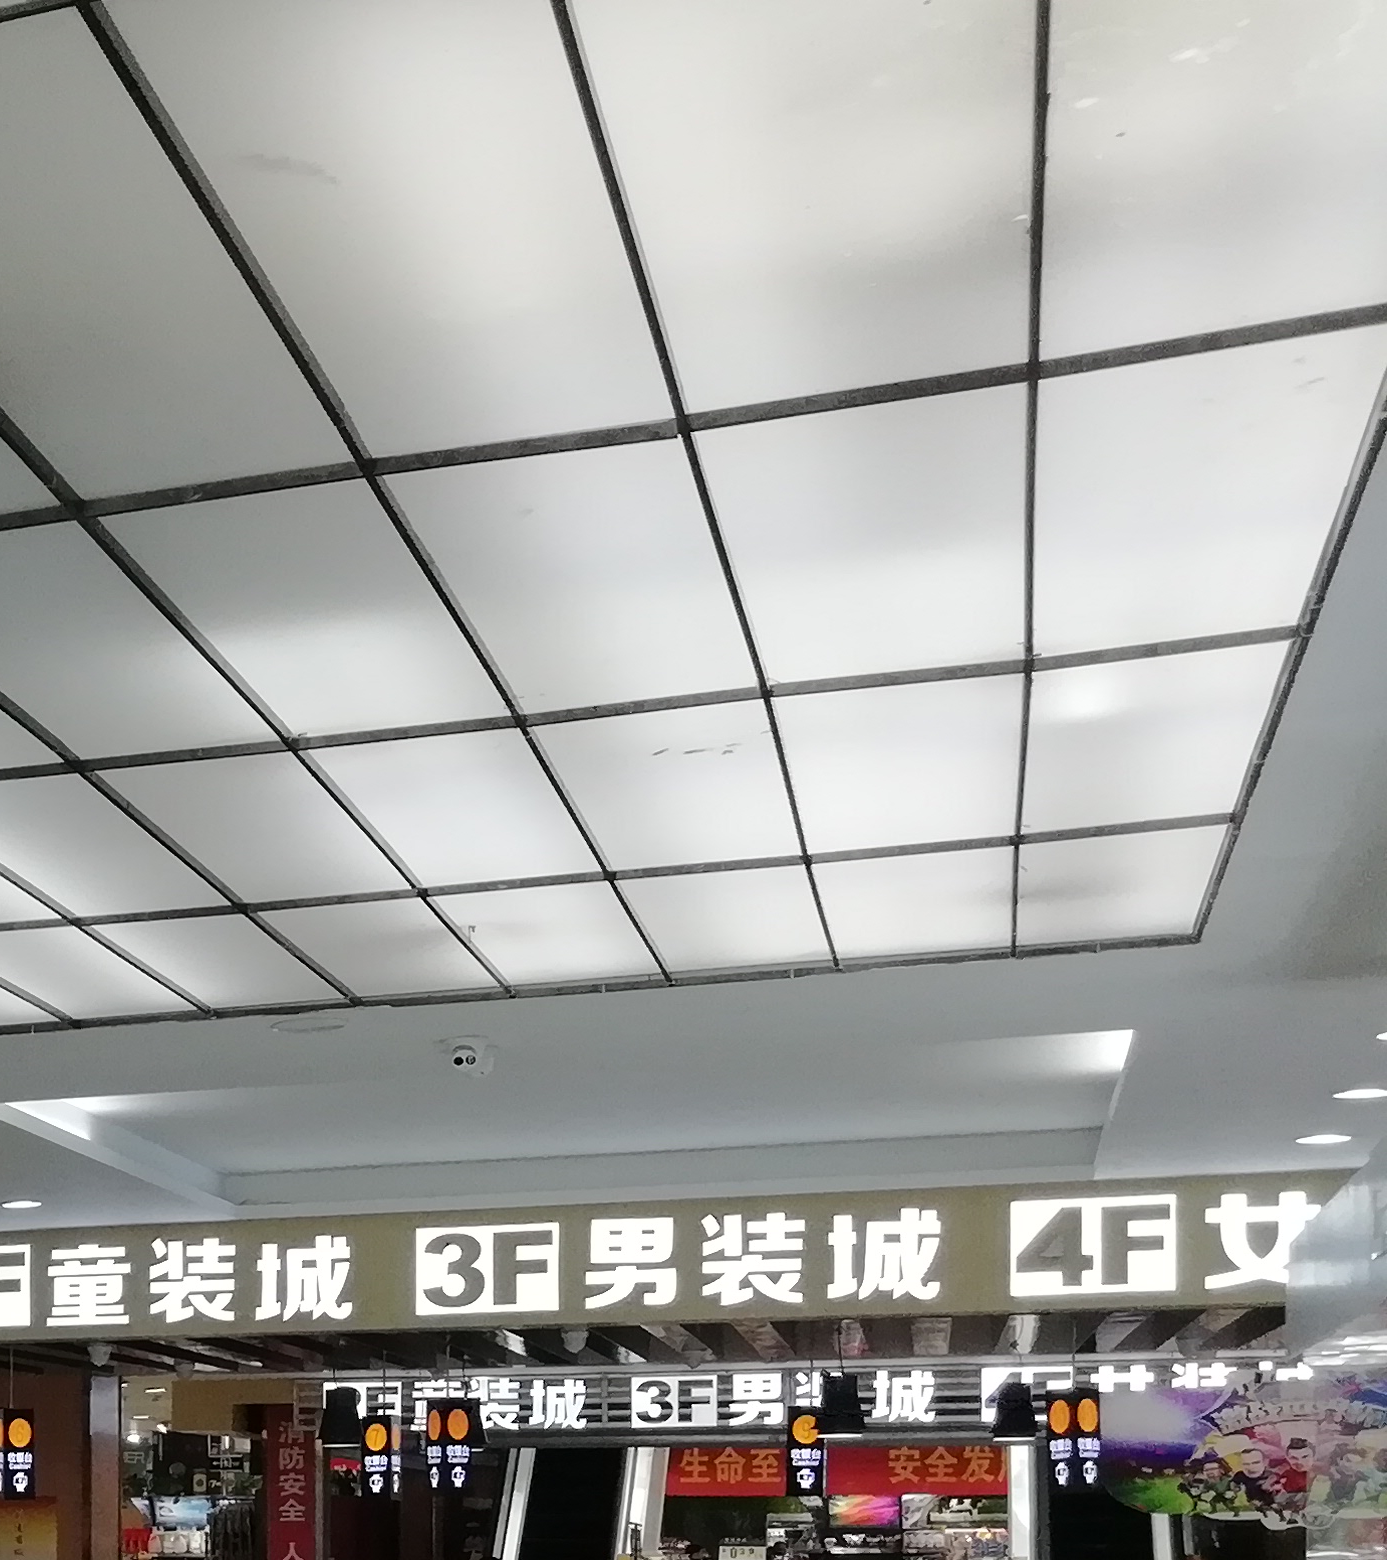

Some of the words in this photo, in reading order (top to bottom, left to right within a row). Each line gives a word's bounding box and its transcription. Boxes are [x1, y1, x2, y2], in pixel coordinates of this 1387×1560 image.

[46, 1235, 354, 1327] 童装城
[424, 1230, 553, 1307] 3F
[584, 1207, 942, 1310] 男装城
[1016, 1203, 1171, 1287] 4F
[635, 1378, 713, 1426] 3F
[278, 1421, 307, 1523] 消防安全
